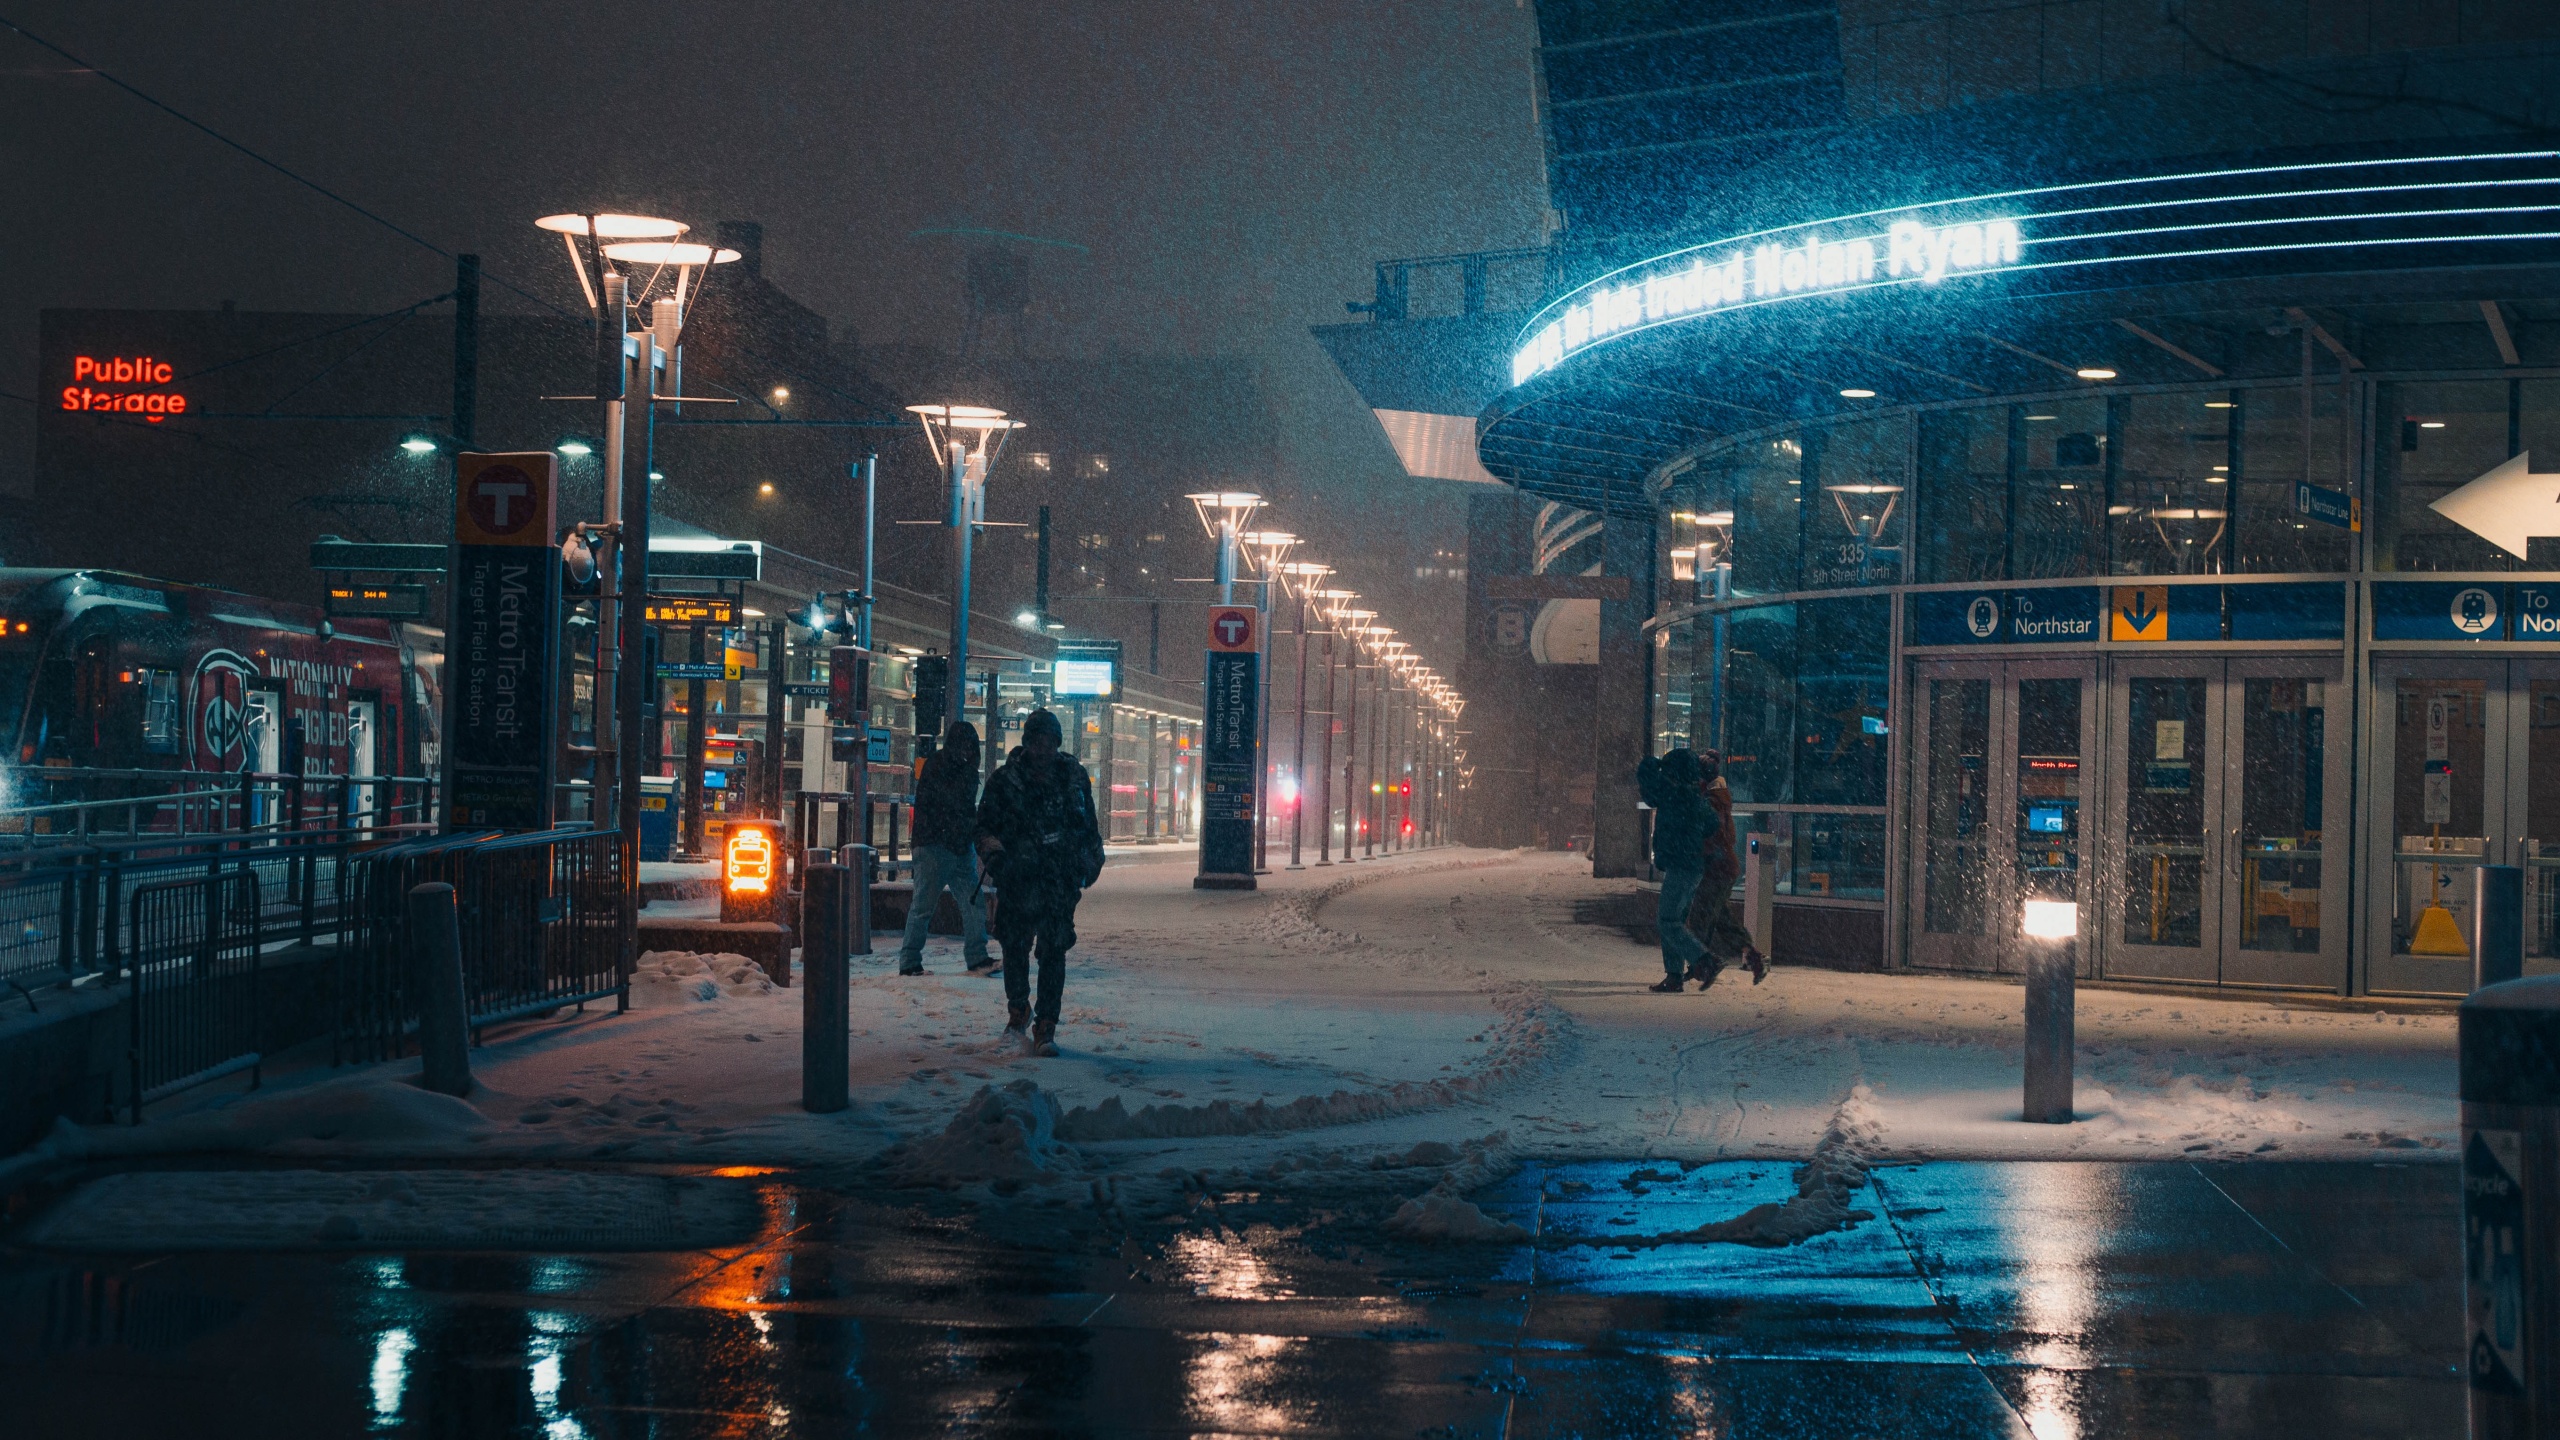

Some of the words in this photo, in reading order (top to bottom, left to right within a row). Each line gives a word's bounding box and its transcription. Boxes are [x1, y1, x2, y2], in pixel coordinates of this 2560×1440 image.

[1646, 251, 1744, 318] traded
[1755, 236, 1872, 296] Nolan
[1890, 221, 2018, 284] Ryan
[75, 356, 173, 384] Public
[62, 386, 186, 423] Storage
[2338, 504, 2348, 520] Line
[1839, 543, 1865, 564] 335
[1813, 569, 1828, 584] 5th
[1831, 567, 1860, 582] Street
[1862, 565, 1889, 580] North
[470, 563, 490, 614] Target
[2522, 590, 2548, 608] To
[2015, 596, 2033, 613] To
[2015, 616, 2092, 635] Northstar
[472, 620, 488, 662] Field
[1216, 660, 1226, 687] Target
[468, 665, 486, 727] Station
[1217, 689, 1225, 711] Field
[1216, 712, 1224, 743] Station
[871, 749, 886, 757] LOOK
